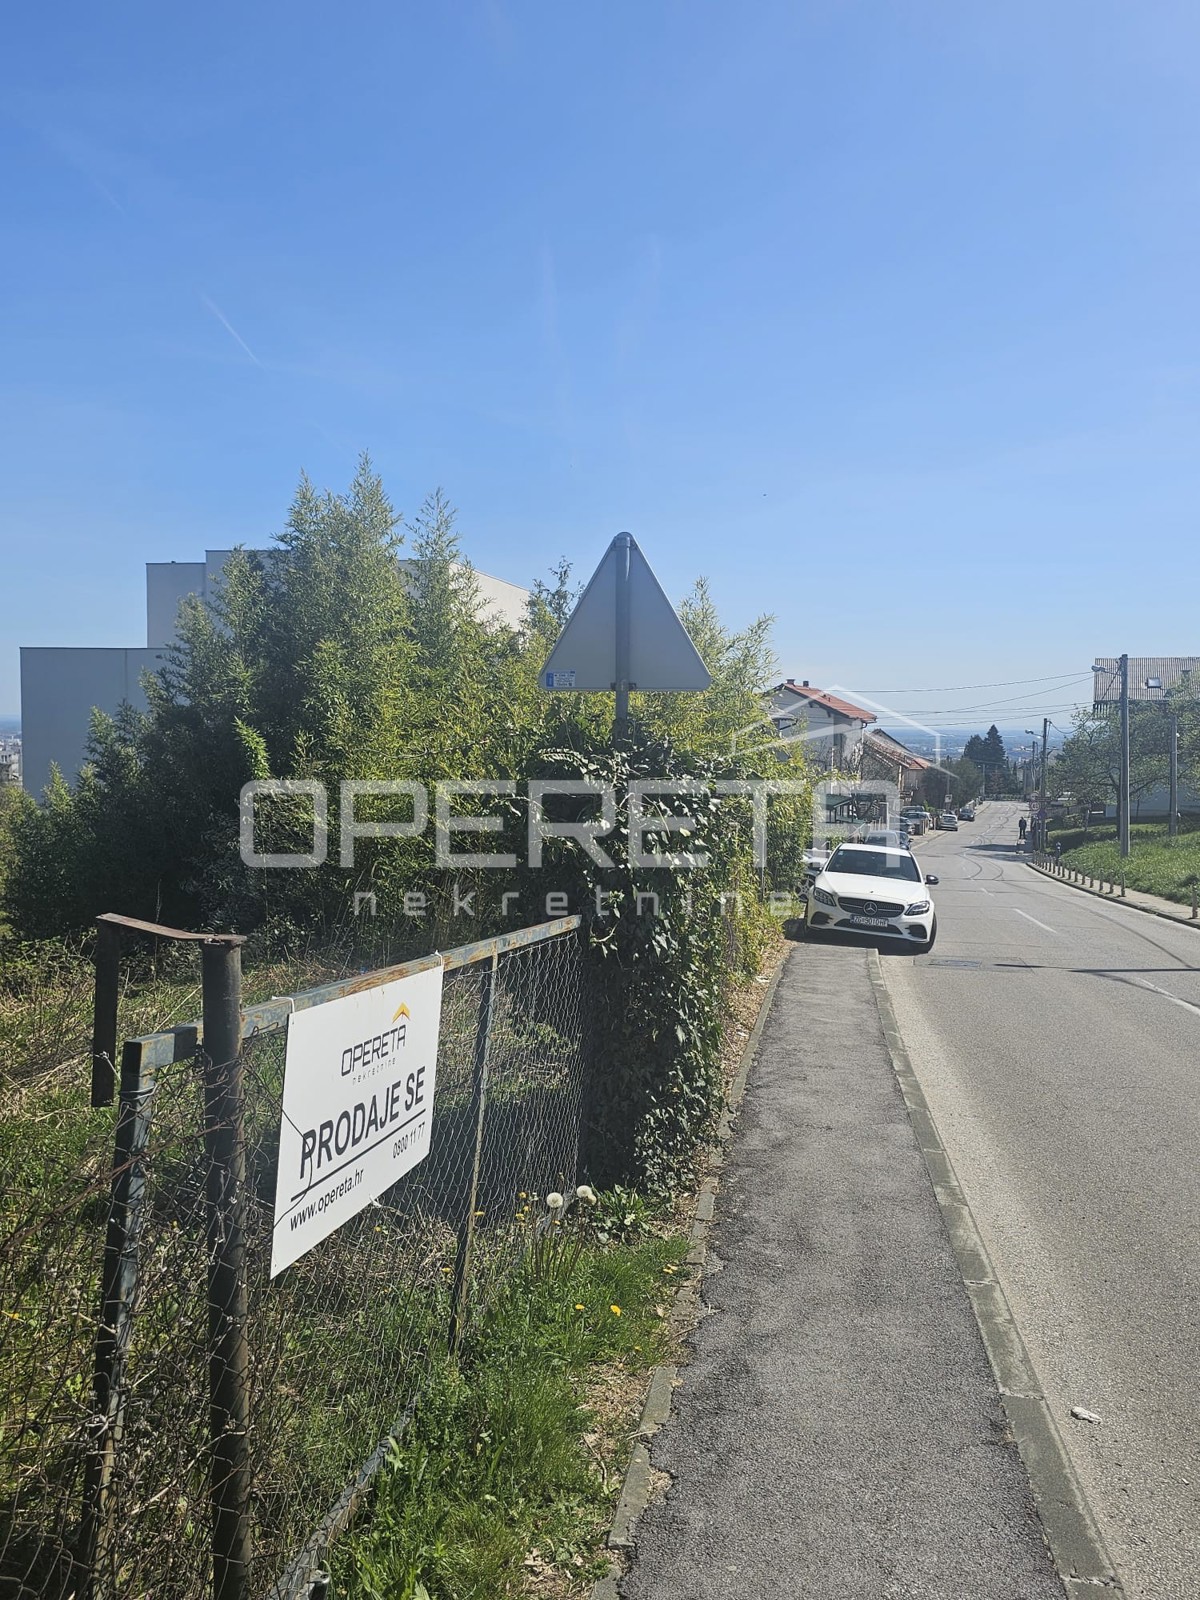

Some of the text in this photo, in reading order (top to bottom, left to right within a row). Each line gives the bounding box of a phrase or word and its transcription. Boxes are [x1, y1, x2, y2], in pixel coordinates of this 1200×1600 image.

[341, 1025, 406, 1077] OPERETA
[300, 1066, 426, 1179] PRODAJE SE
[289, 1169, 365, 1231] www.opereta.hr
